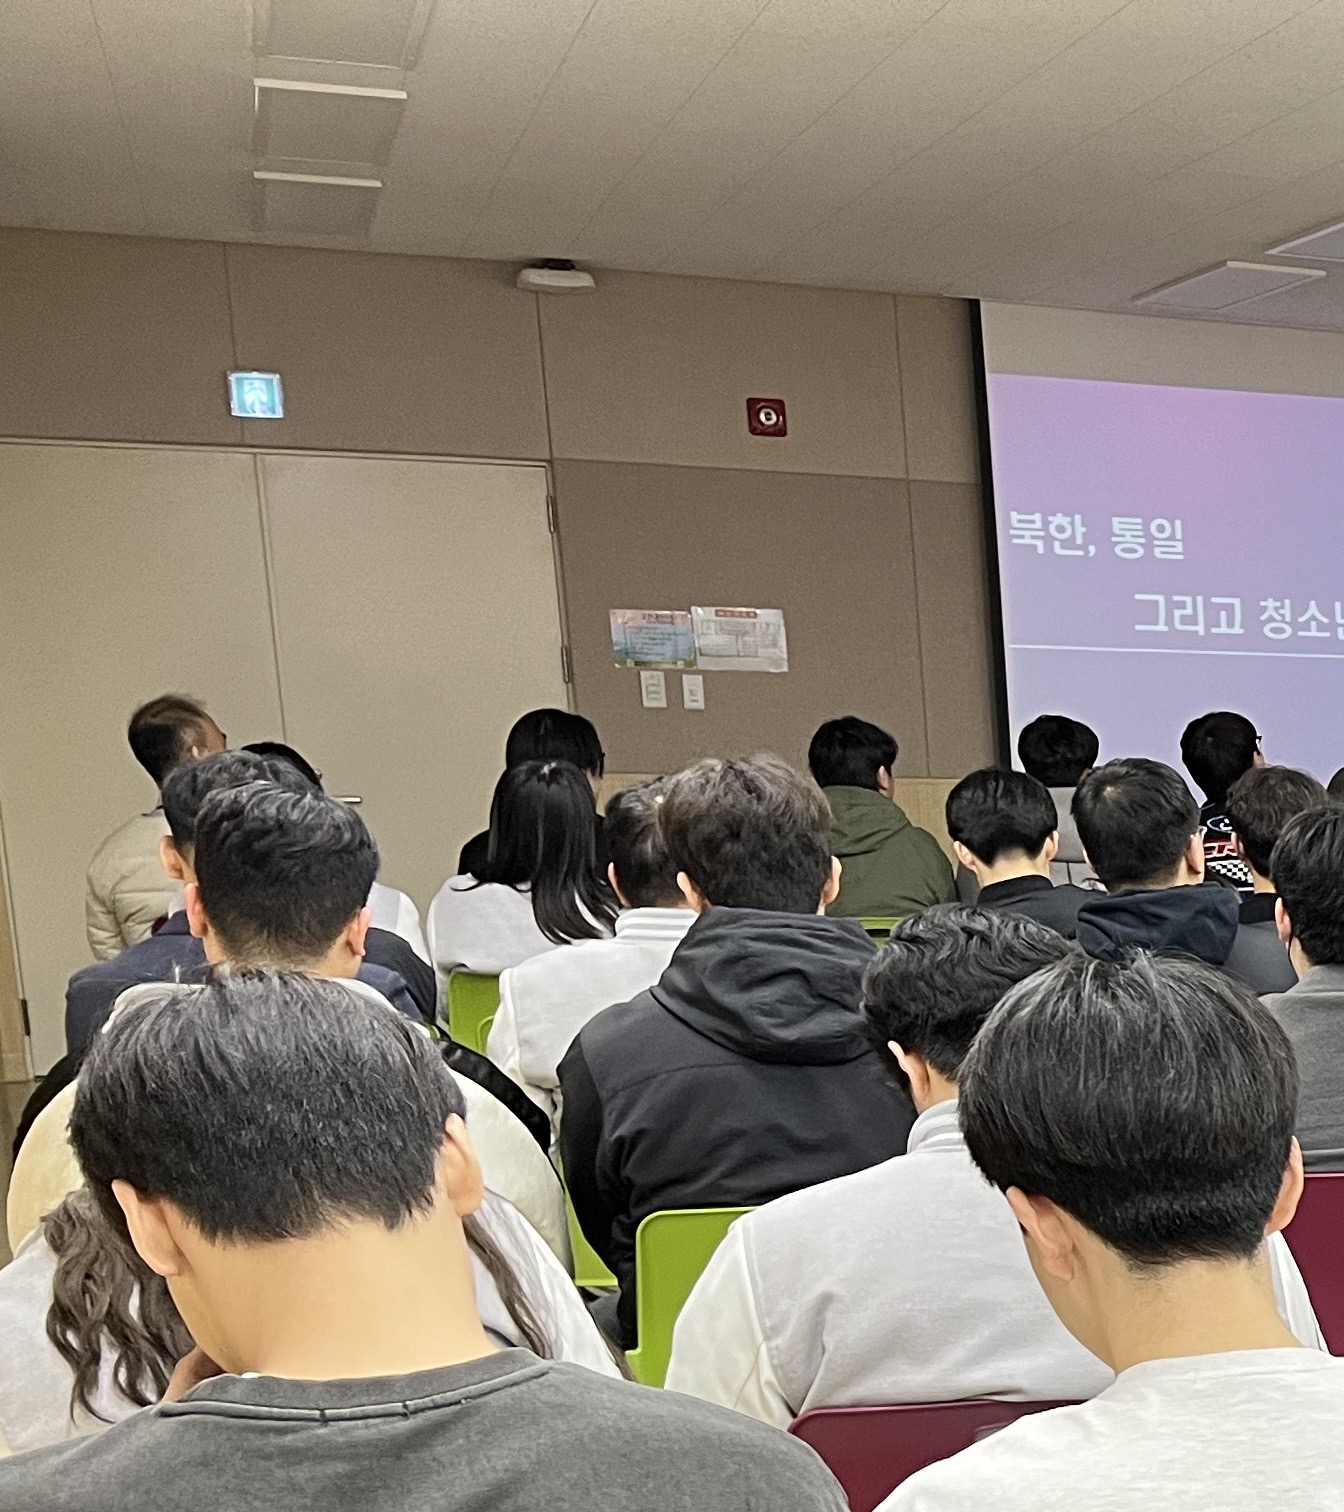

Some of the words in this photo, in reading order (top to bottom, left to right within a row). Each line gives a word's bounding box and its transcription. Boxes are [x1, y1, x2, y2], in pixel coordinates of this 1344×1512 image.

[1009, 511, 1096, 557] 북한,
[1111, 516, 1184, 560] 통일
[1134, 593, 1245, 636] 그리고
